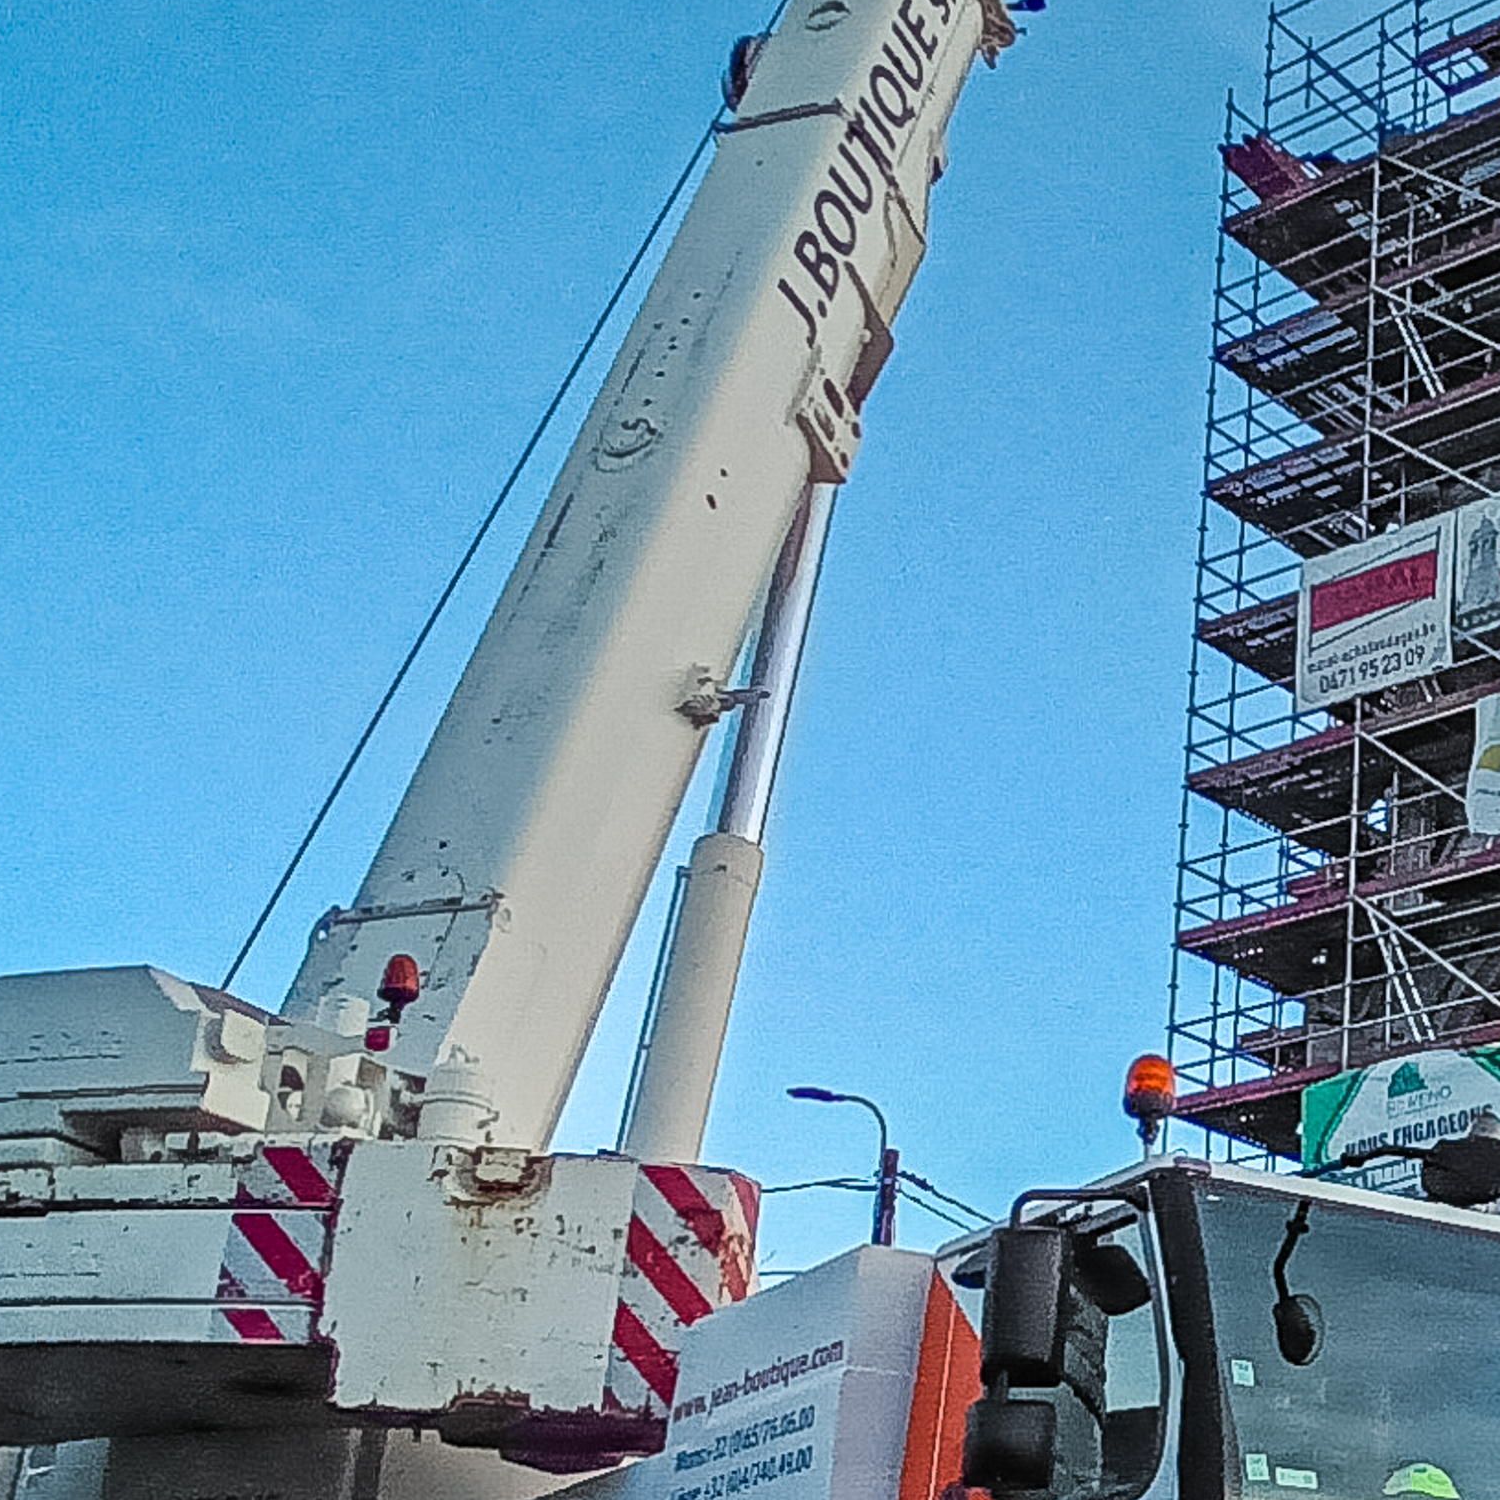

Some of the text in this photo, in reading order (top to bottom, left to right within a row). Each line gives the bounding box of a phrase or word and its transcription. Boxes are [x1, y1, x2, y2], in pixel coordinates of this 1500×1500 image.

[1358, 659, 1379, 681] 95
[1382, 652, 1401, 675] 23
[1405, 643, 1426, 666] 09
